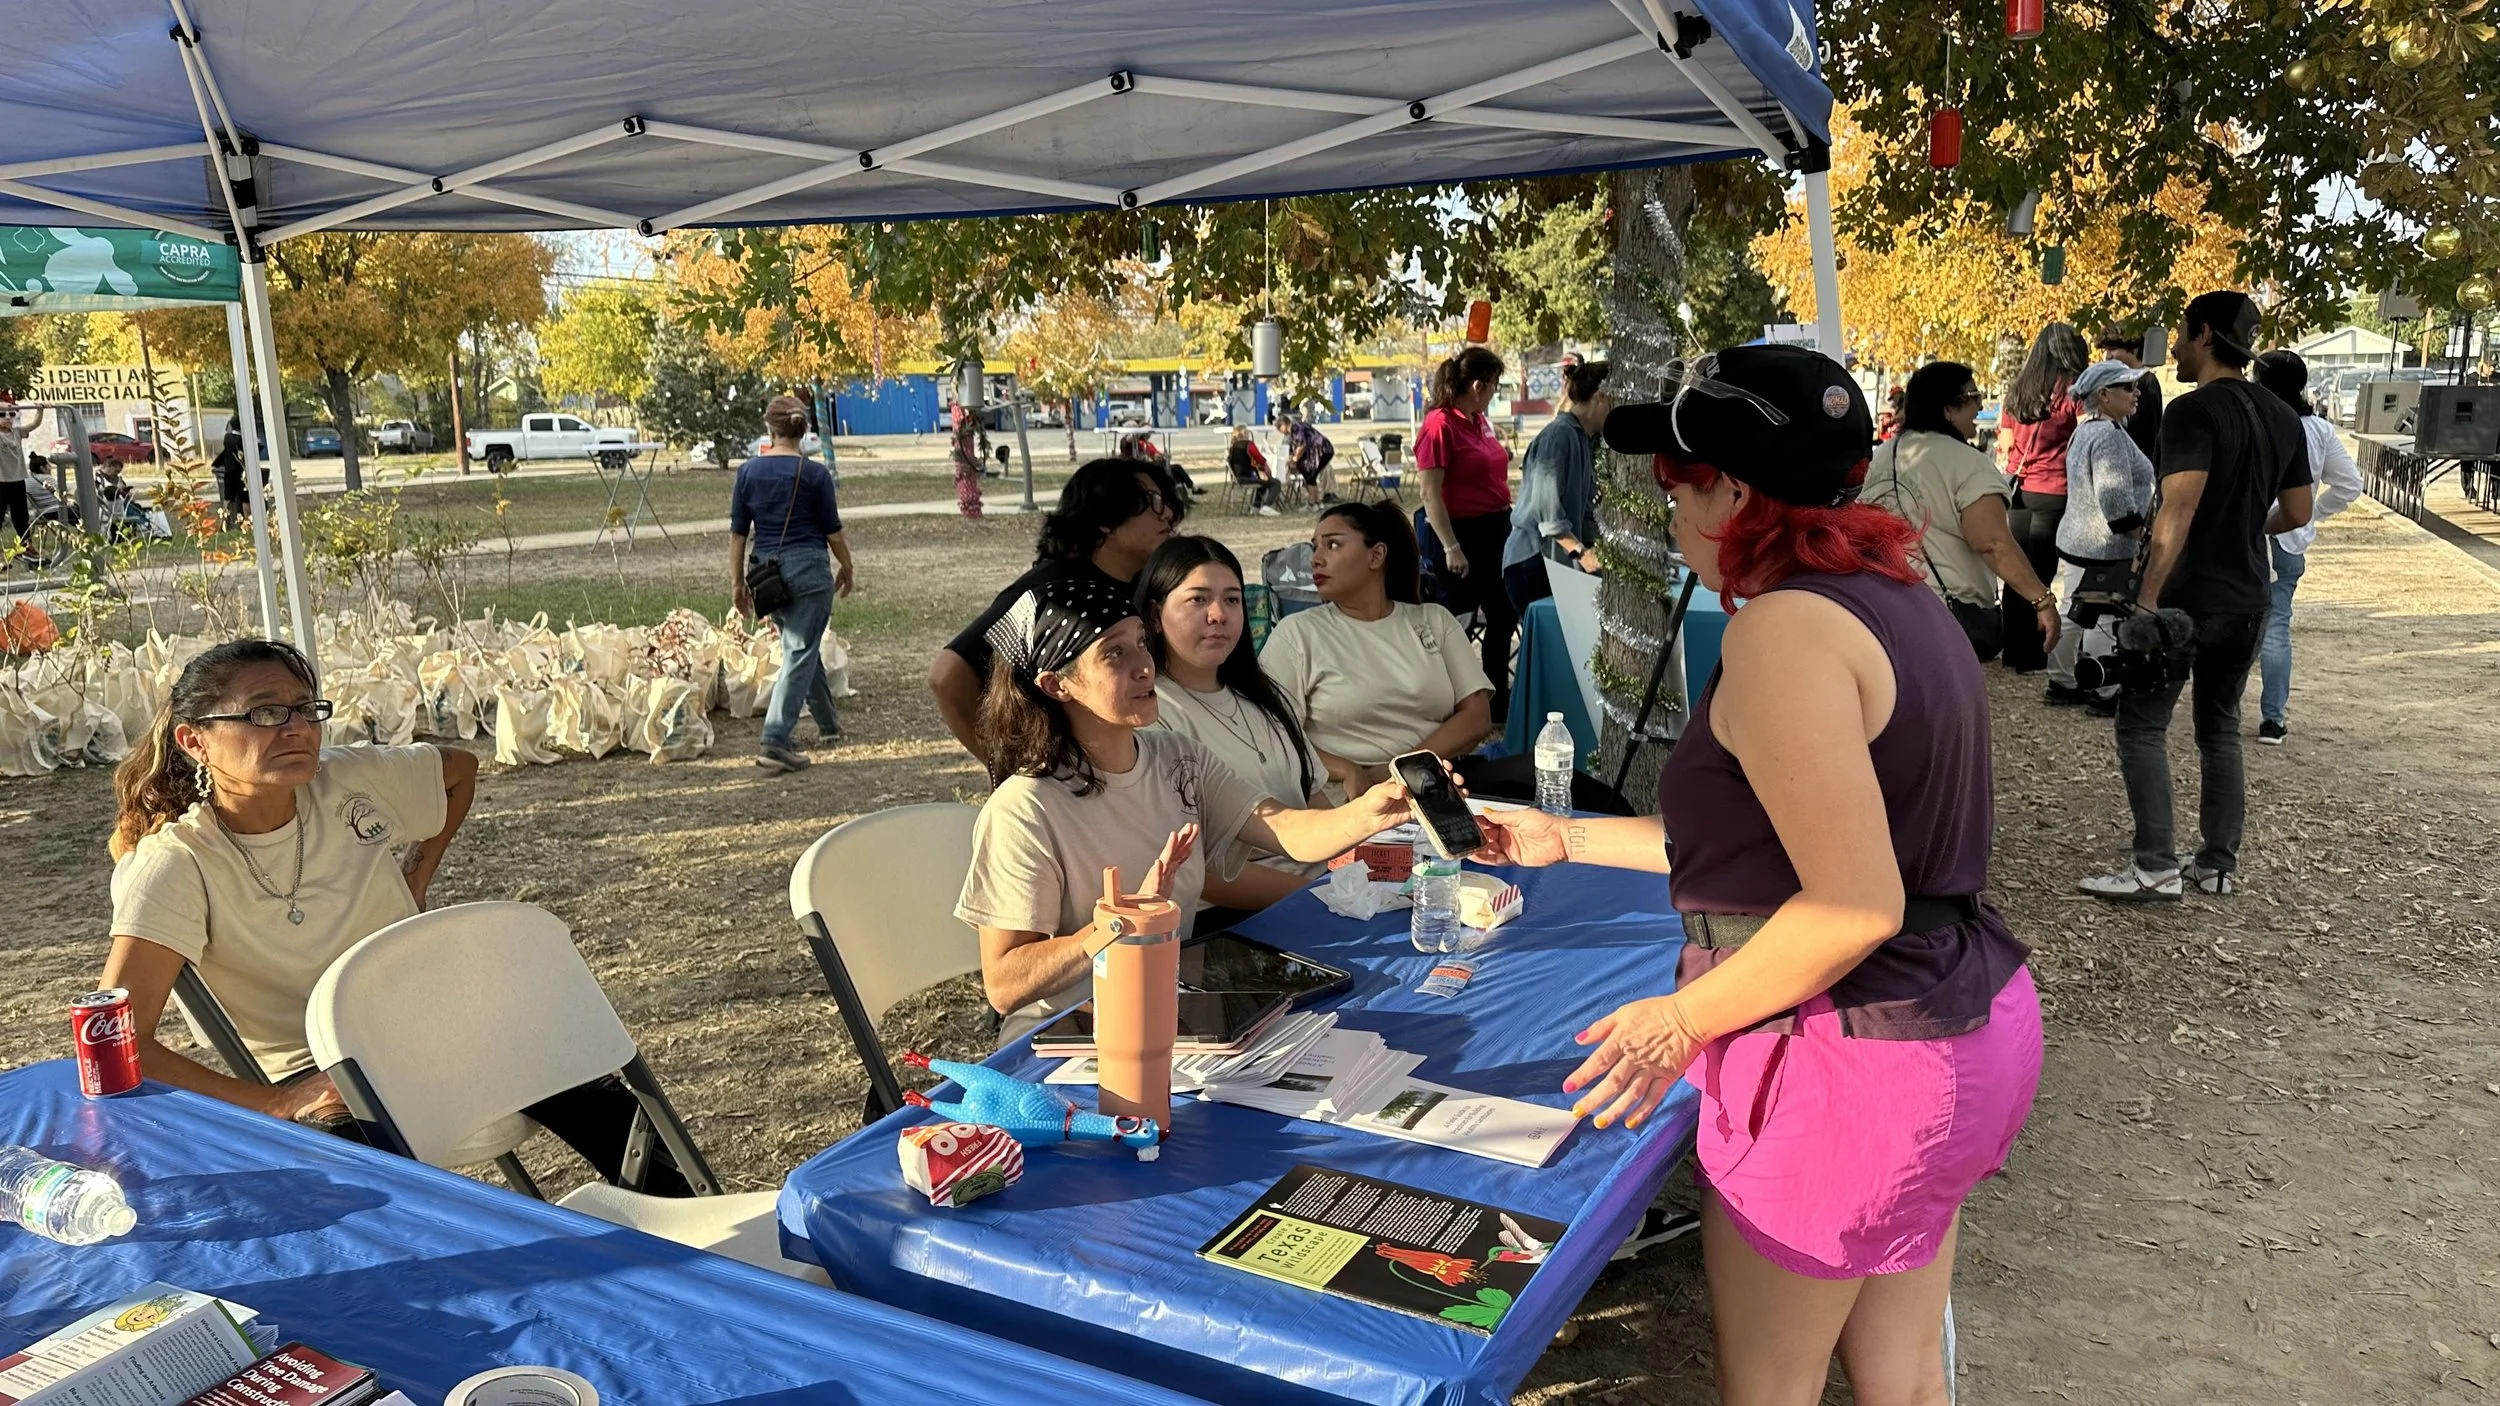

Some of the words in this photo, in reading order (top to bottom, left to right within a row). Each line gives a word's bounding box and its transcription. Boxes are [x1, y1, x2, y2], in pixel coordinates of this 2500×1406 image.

[160, 243, 210, 259] CAPRA
[160, 255, 211, 267] ACCREDITED
[32, 368, 148, 385] SIDENTIA
[26, 385, 148, 401] OMMERCIAL
[960, 1139, 983, 1158] FRESH
[1256, 1226, 1312, 1264] Texas
[1265, 1227, 1288, 1245] Create
[1280, 1231, 1328, 1270] Wildscape
[200, 1318, 213, 1335] What
[216, 1338, 236, 1365] Certified
[129, 1355, 145, 1377] Finding
[147, 1379, 166, 1402] Arborist
[259, 1360, 285, 1378] Tree
[284, 1370, 329, 1394] Damage
[273, 1352, 325, 1380] Avoiding
[241, 1368, 285, 1394] During
